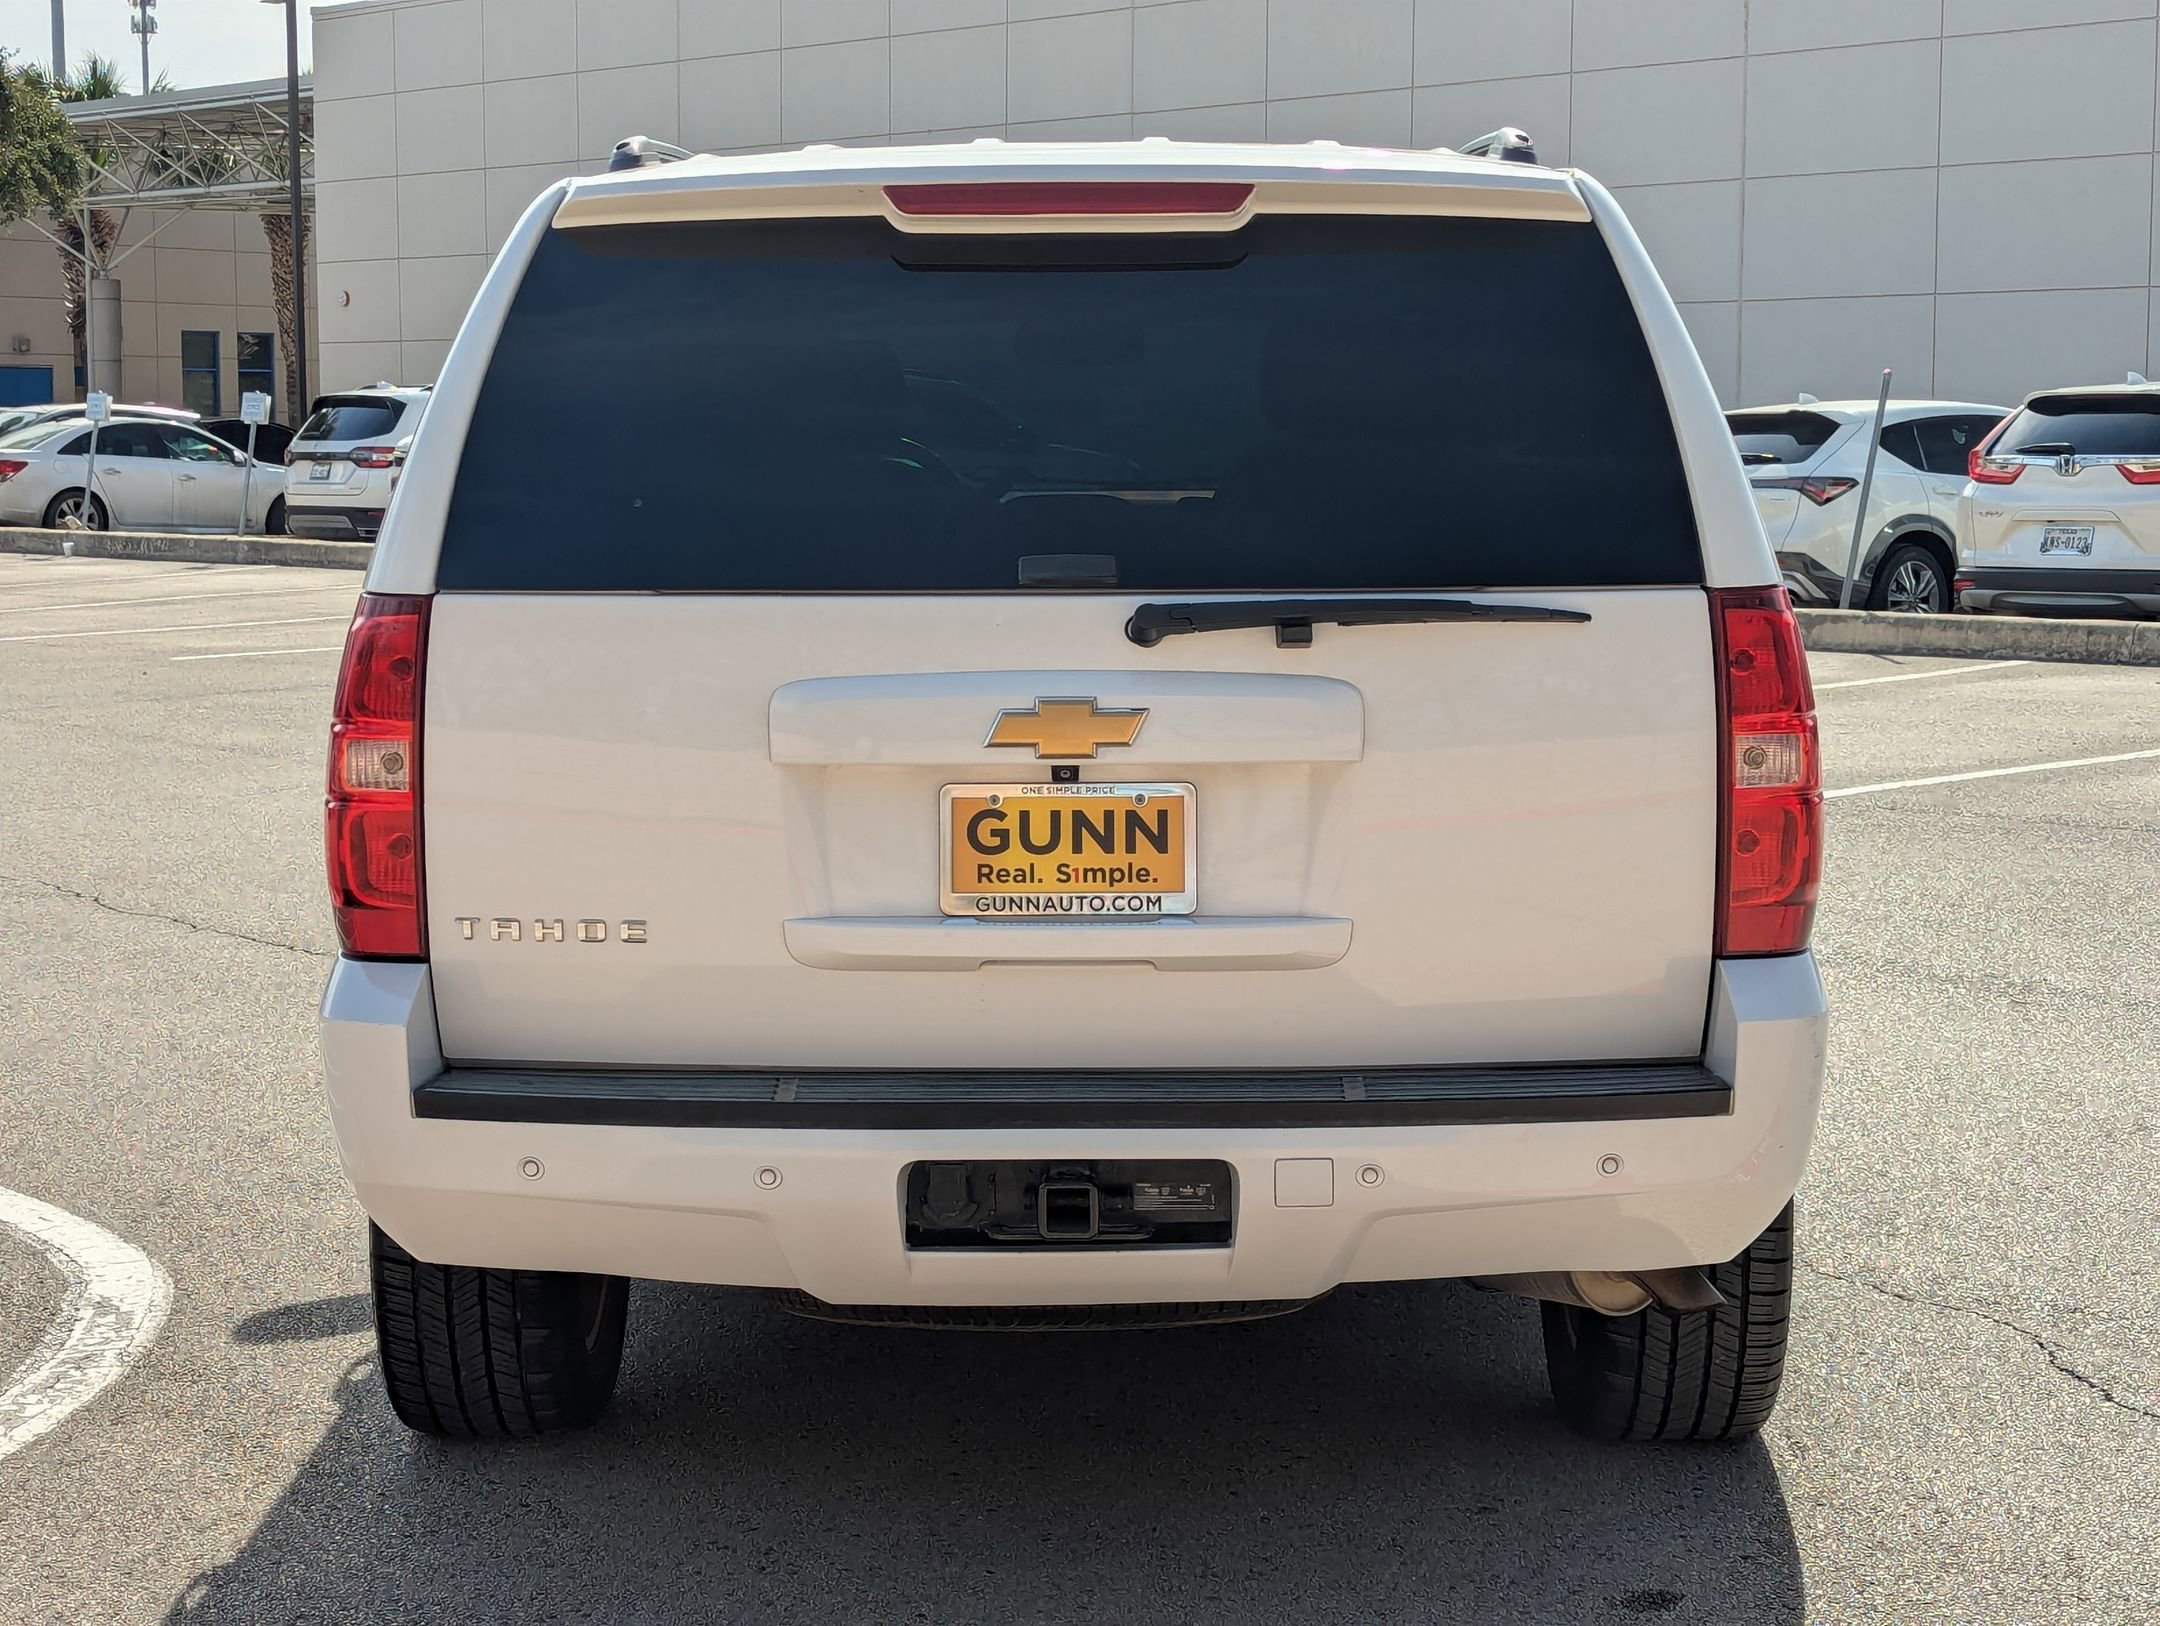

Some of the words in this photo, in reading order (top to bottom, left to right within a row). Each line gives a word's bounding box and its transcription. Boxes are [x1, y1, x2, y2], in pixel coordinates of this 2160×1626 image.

[1021, 786, 1044, 795] ONE
[1047, 786, 1083, 795] SIMPLE
[1085, 786, 1116, 795] PRICE
[966, 808, 1169, 856] GUNN
[977, 862, 1043, 884] Real.
[975, 895, 1162, 913] GUNNAUTO.COM
[454, 916, 648, 944] TAHOE
